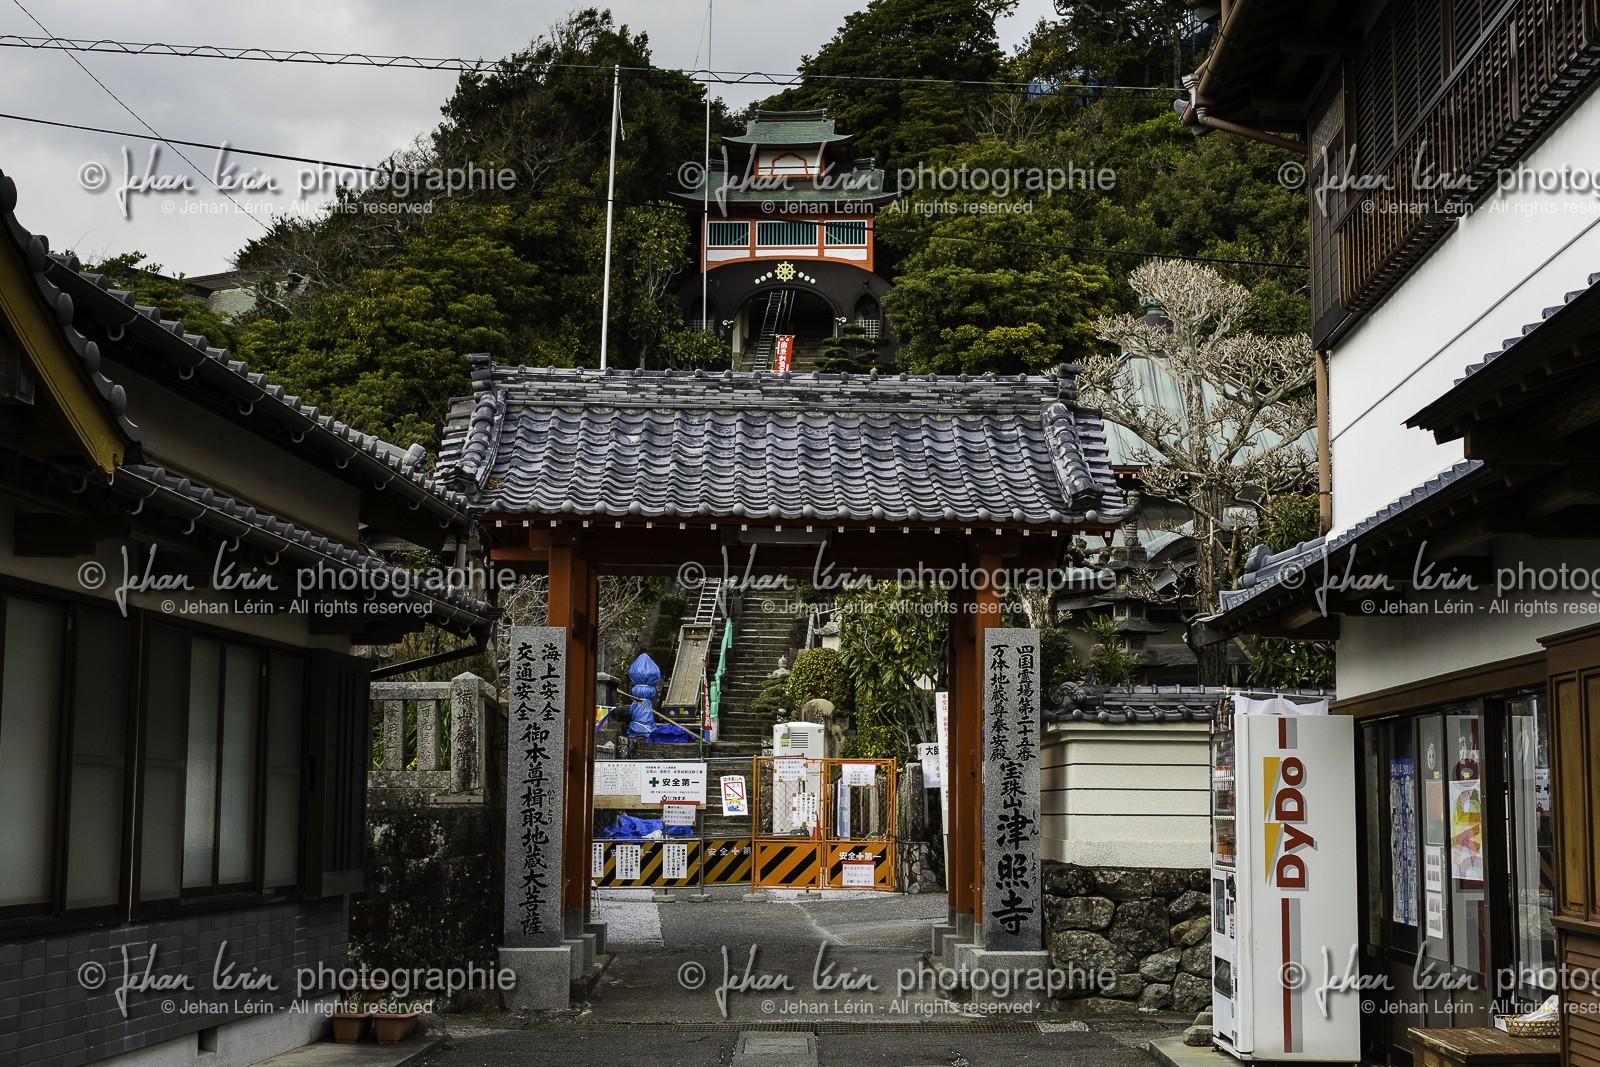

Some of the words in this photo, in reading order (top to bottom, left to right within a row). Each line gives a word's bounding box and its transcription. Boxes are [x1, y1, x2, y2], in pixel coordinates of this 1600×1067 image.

[513, 642, 537, 721] 交通安全
[540, 642, 562, 721] 海上安全
[1016, 645, 1037, 761] 四国霊場第二十五番
[662, 778, 700, 787] 安全第一
[1275, 756, 1318, 888] DyDo
